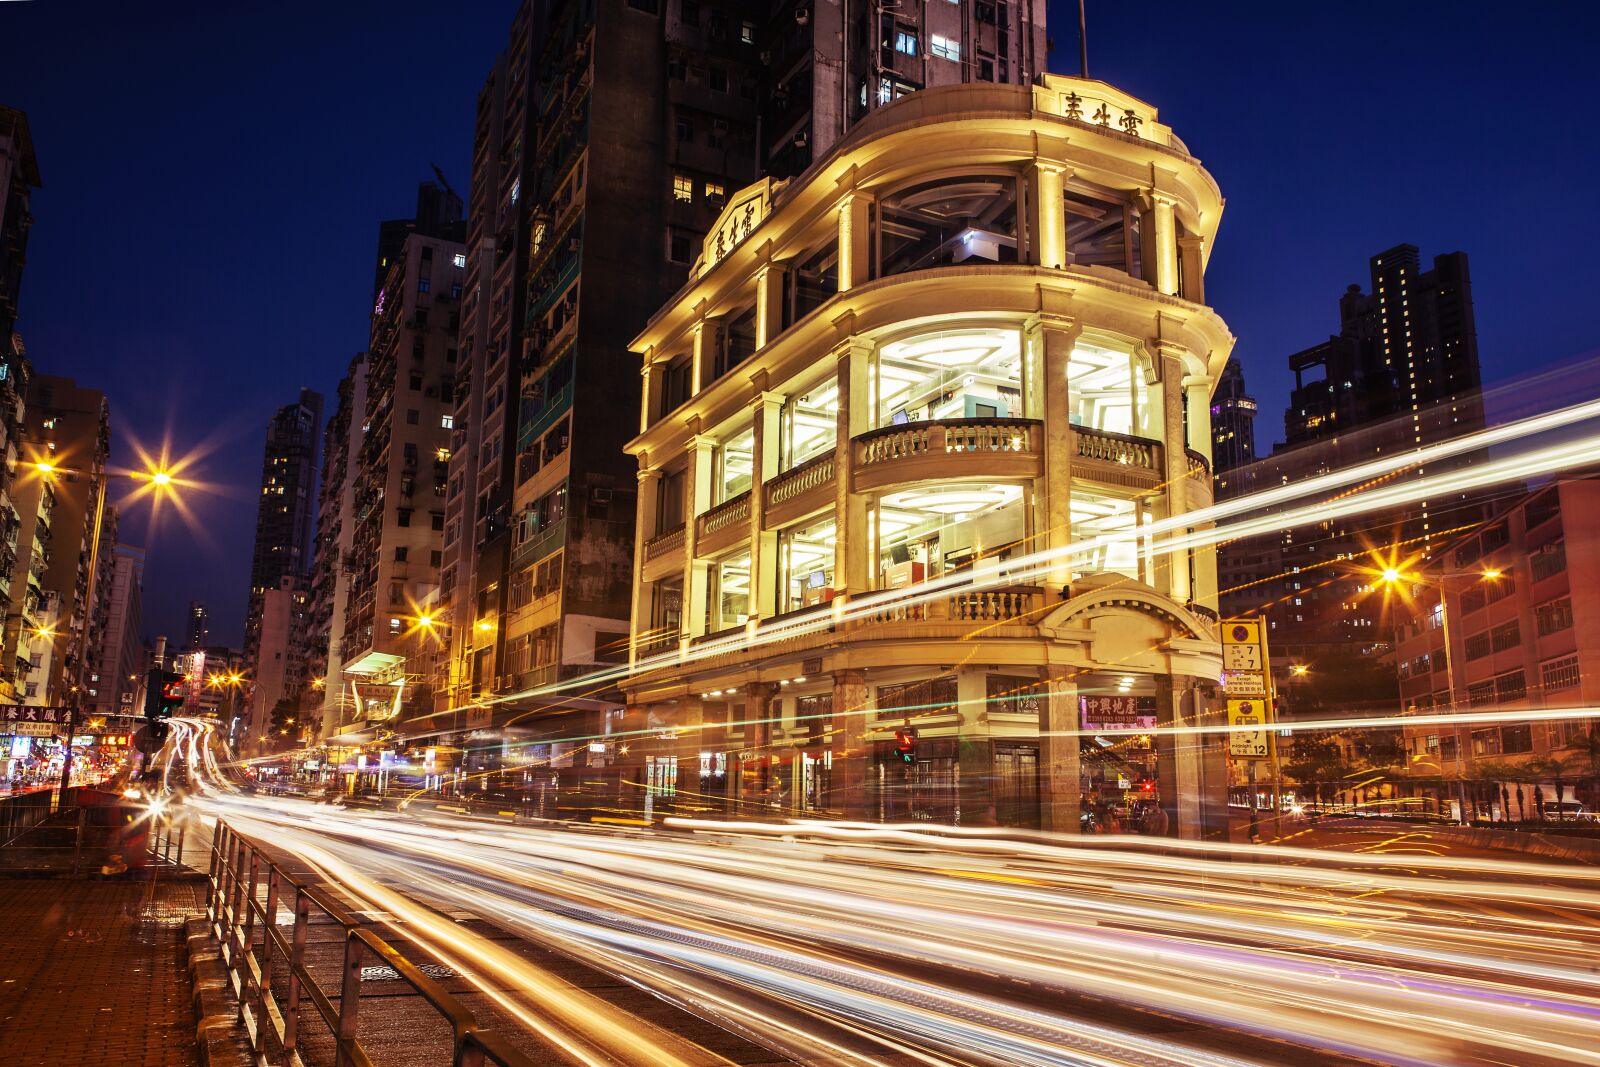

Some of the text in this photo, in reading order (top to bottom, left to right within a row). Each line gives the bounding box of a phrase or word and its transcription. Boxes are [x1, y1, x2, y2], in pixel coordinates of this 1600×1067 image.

[1246, 646, 1253, 655] 7
[1247, 660, 1254, 668] 7
[1087, 697, 1136, 716] 中興地產
[1254, 745, 1266, 754] 12
